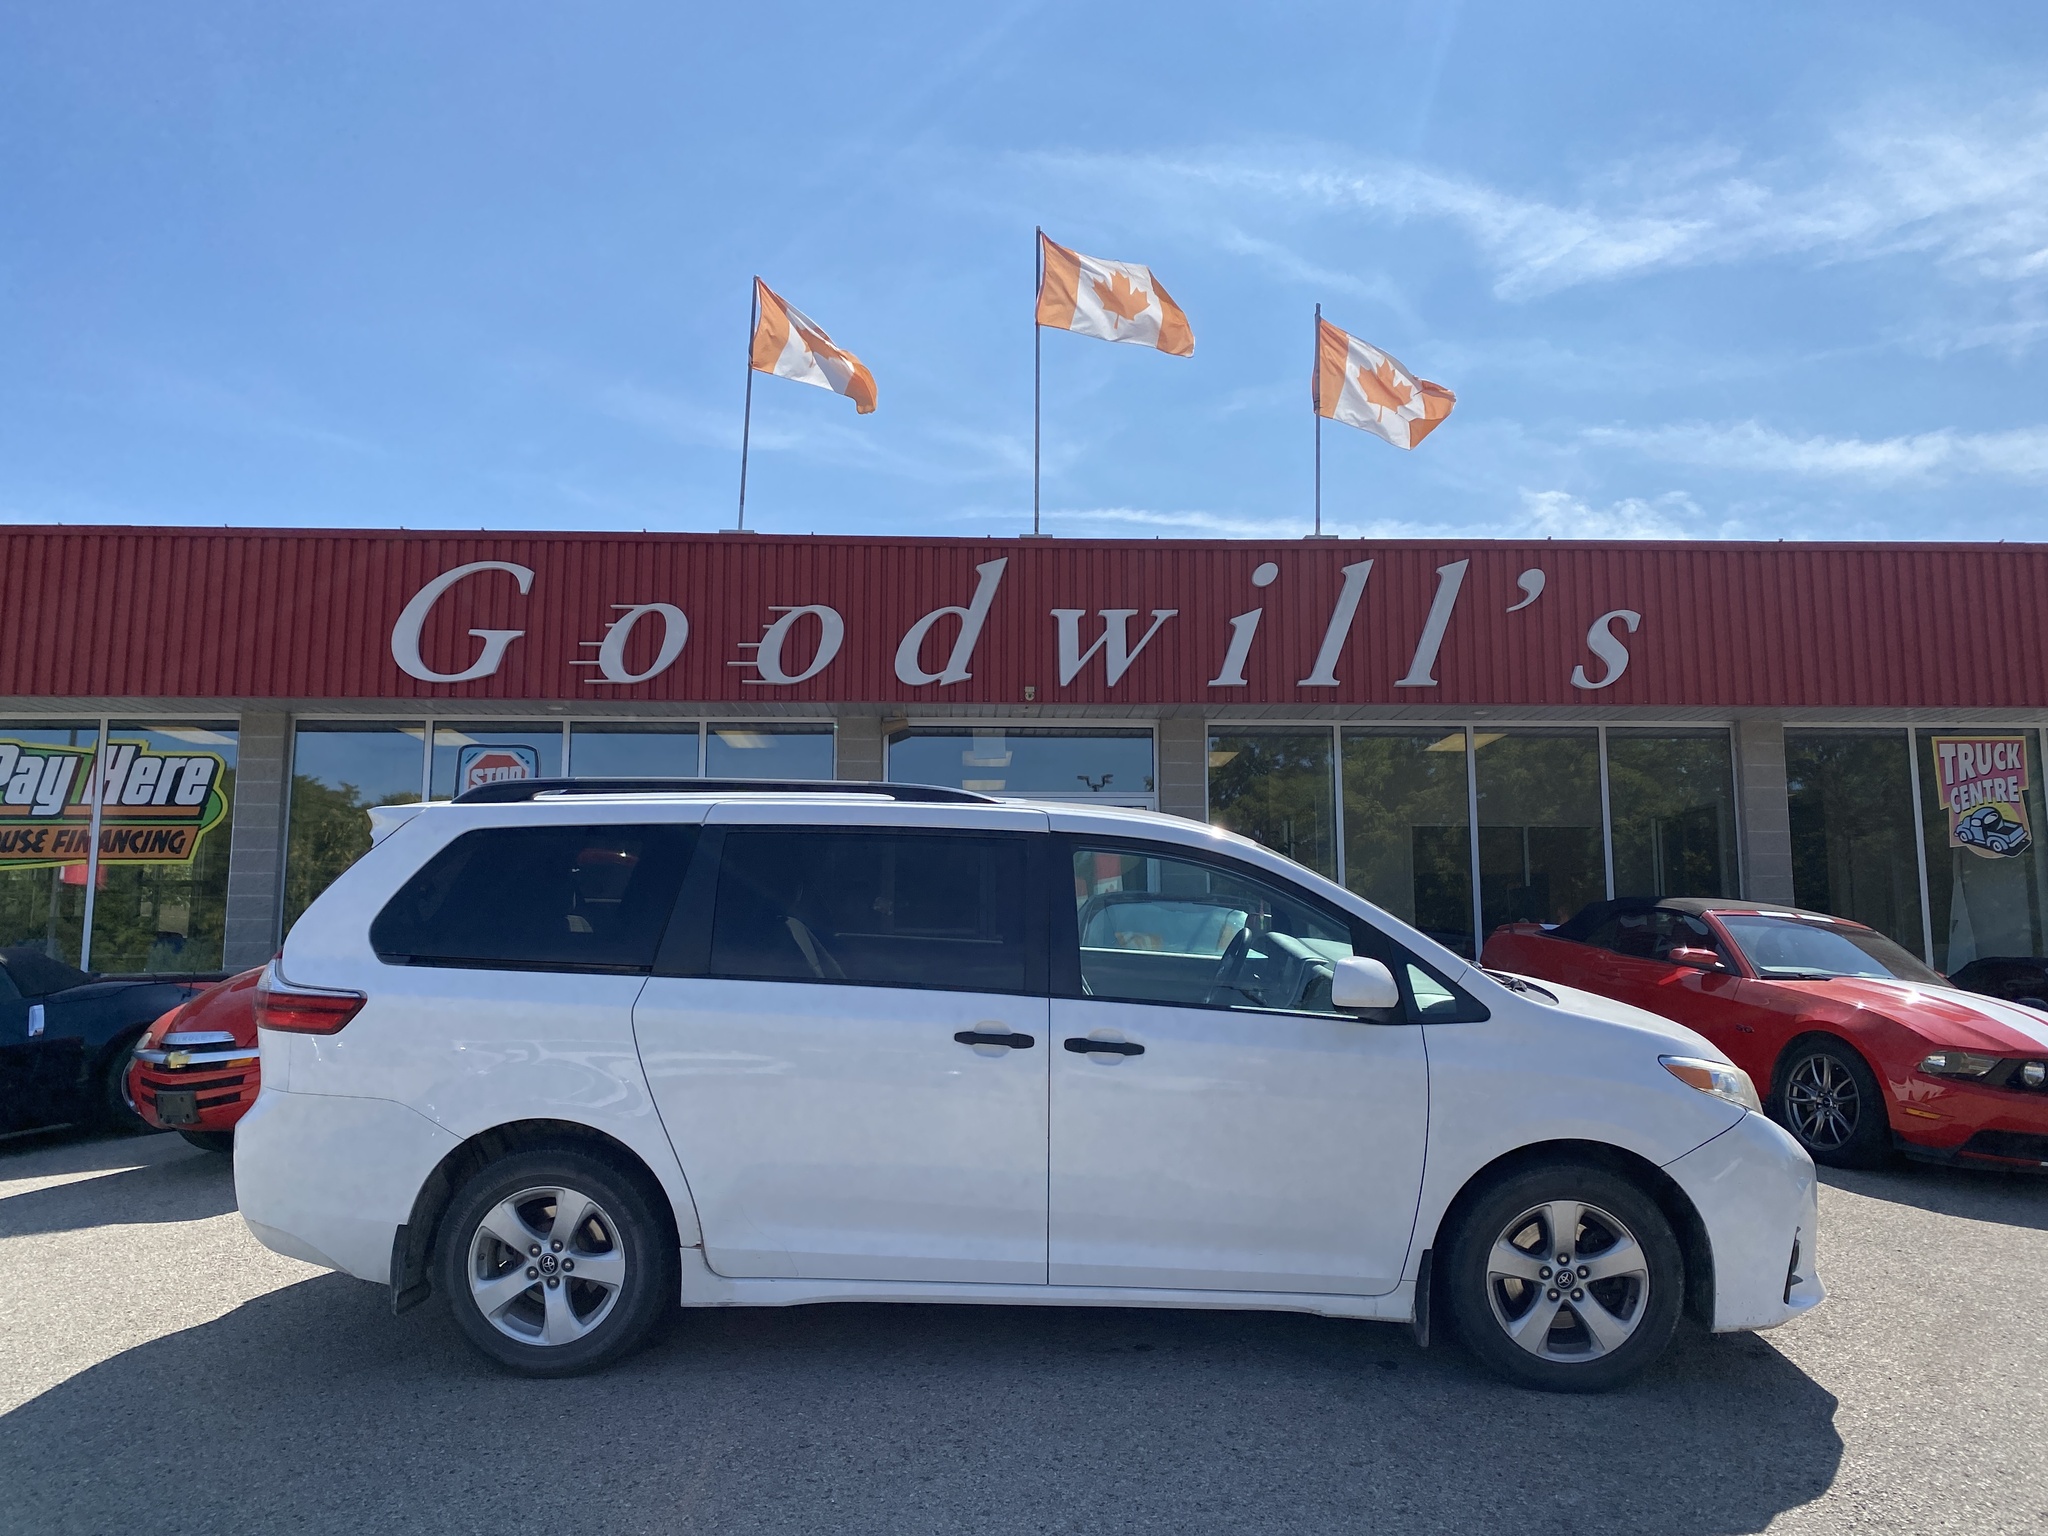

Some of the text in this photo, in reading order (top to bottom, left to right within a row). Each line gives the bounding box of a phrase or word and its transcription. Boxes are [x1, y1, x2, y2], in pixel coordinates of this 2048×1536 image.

[391, 556, 1641, 690] Goodwill's
[80, 744, 215, 806] Here
[1939, 742, 2022, 785] TRUCK
[1950, 775, 2020, 813] CENTRE
[0, 828, 187, 854] USE FINANCING
